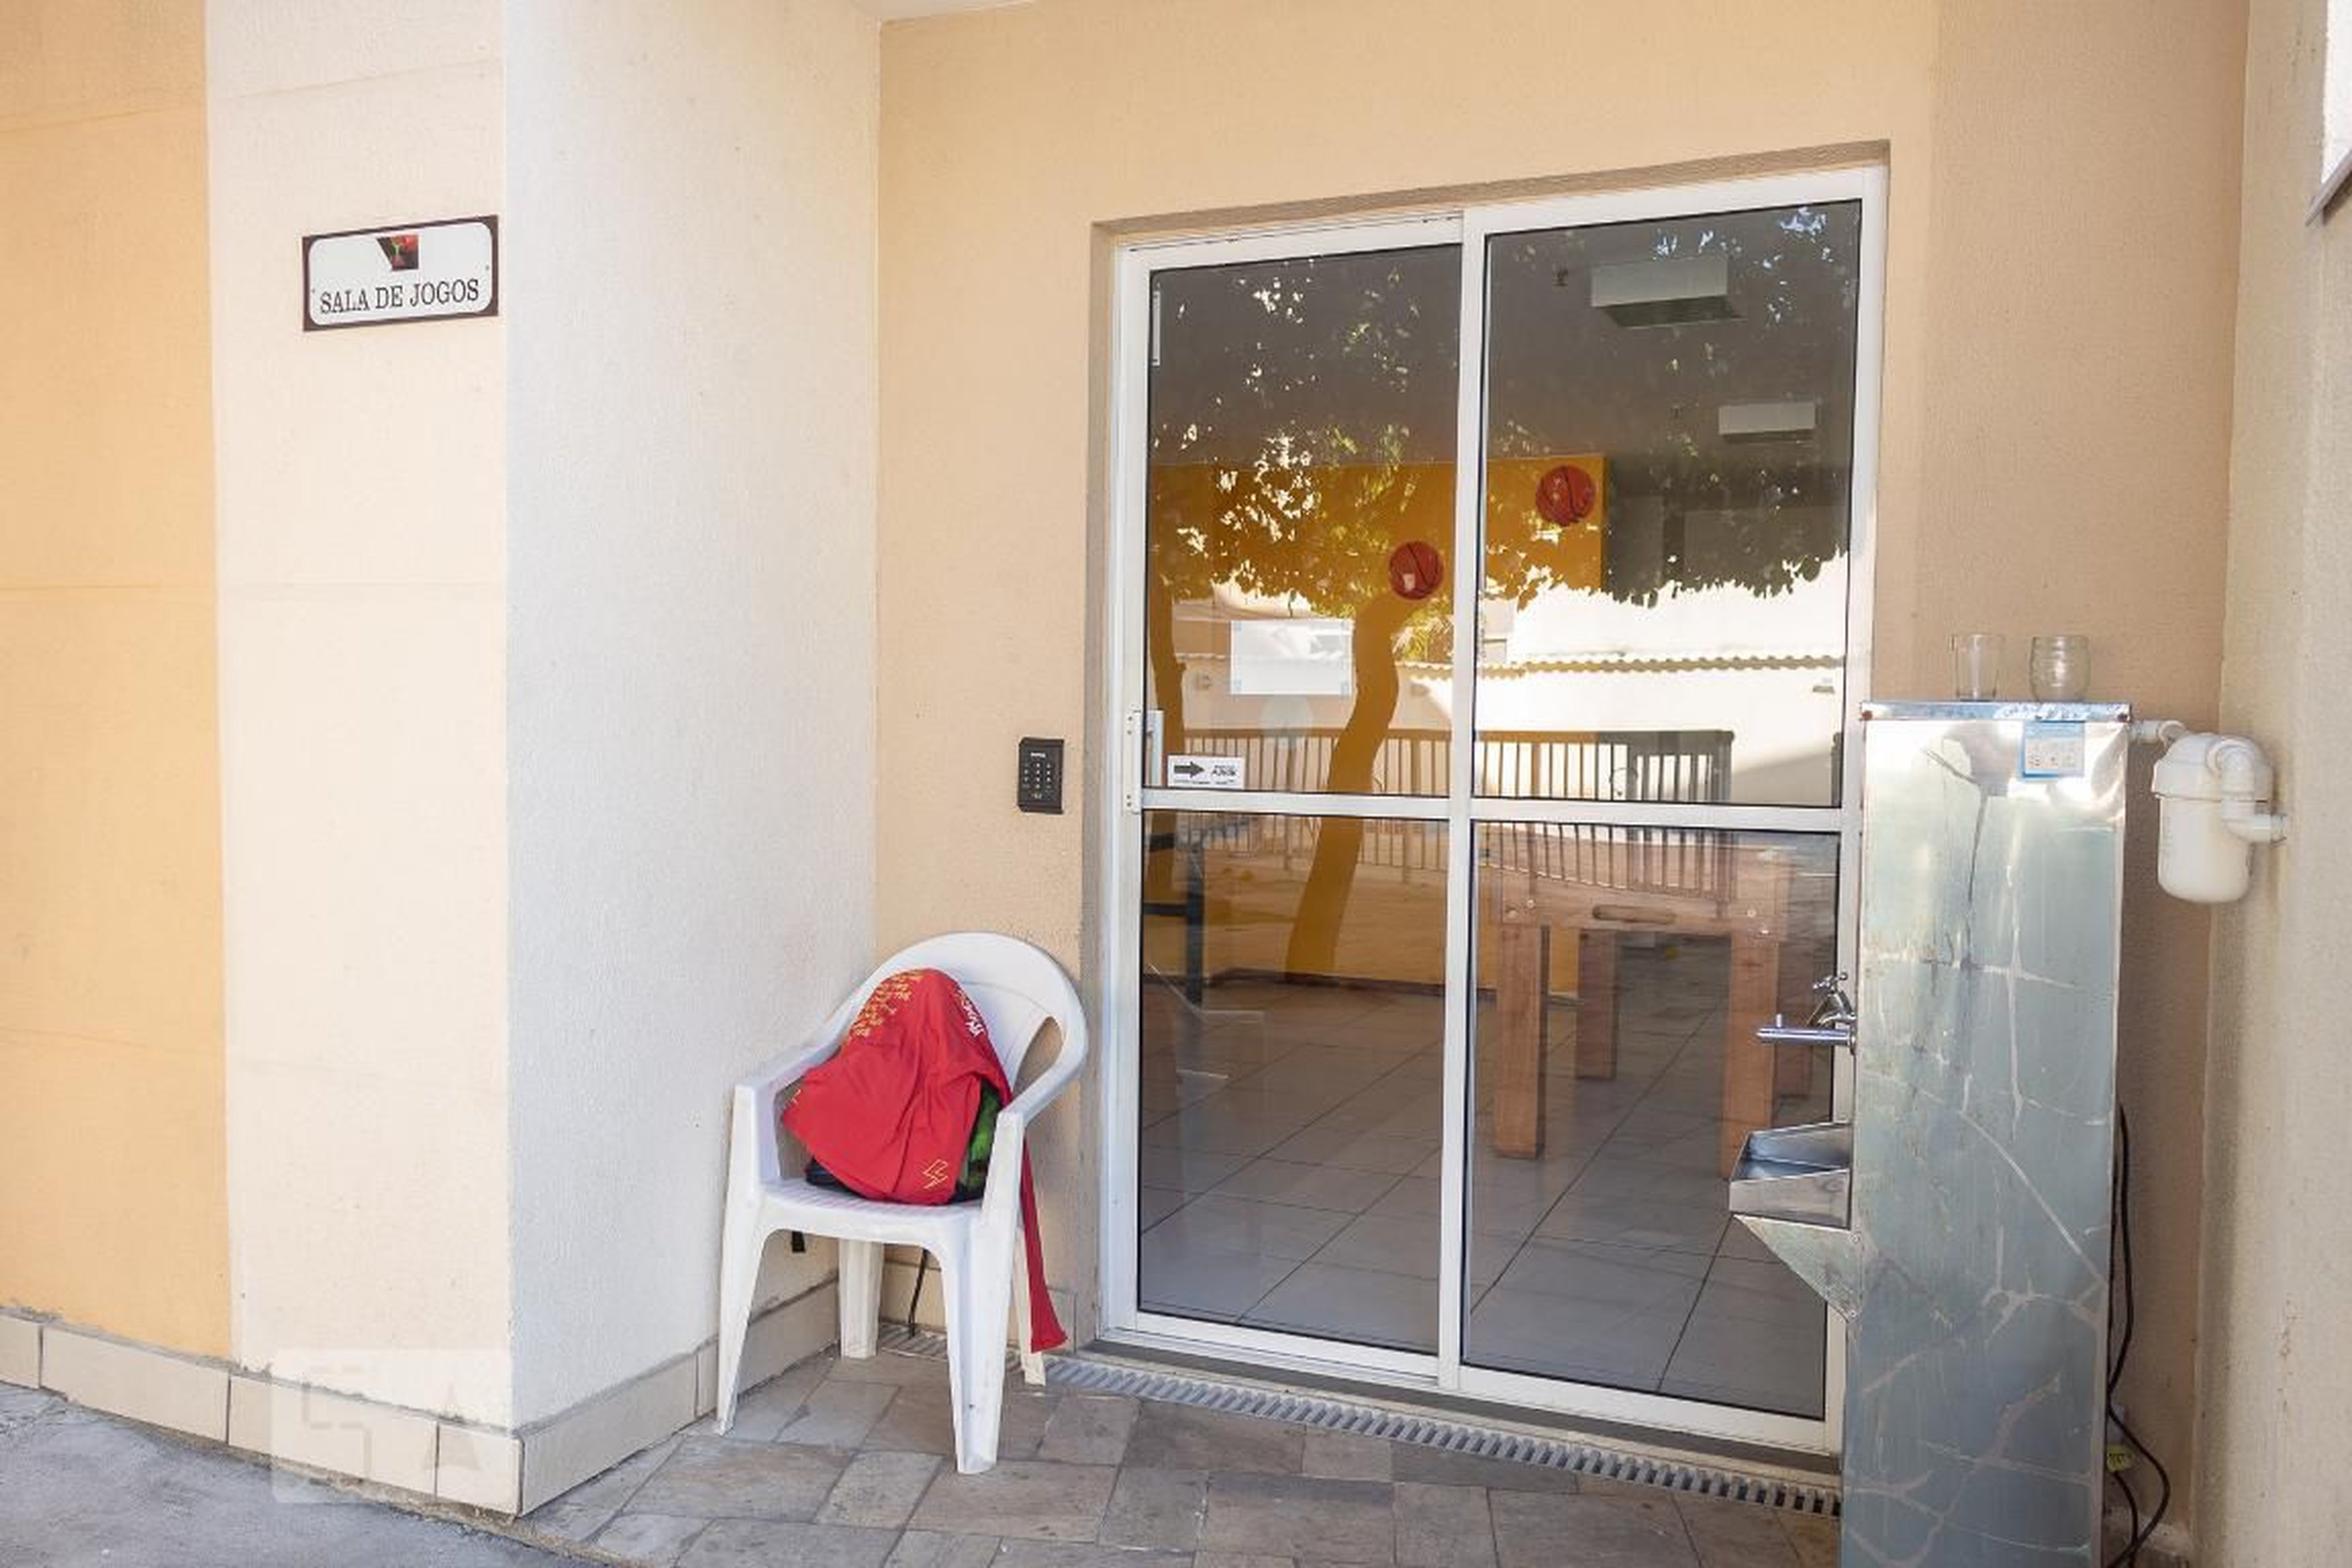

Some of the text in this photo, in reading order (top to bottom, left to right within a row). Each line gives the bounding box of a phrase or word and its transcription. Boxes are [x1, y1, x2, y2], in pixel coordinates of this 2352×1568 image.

[320, 279, 479, 314] SALA DE JOGOS
